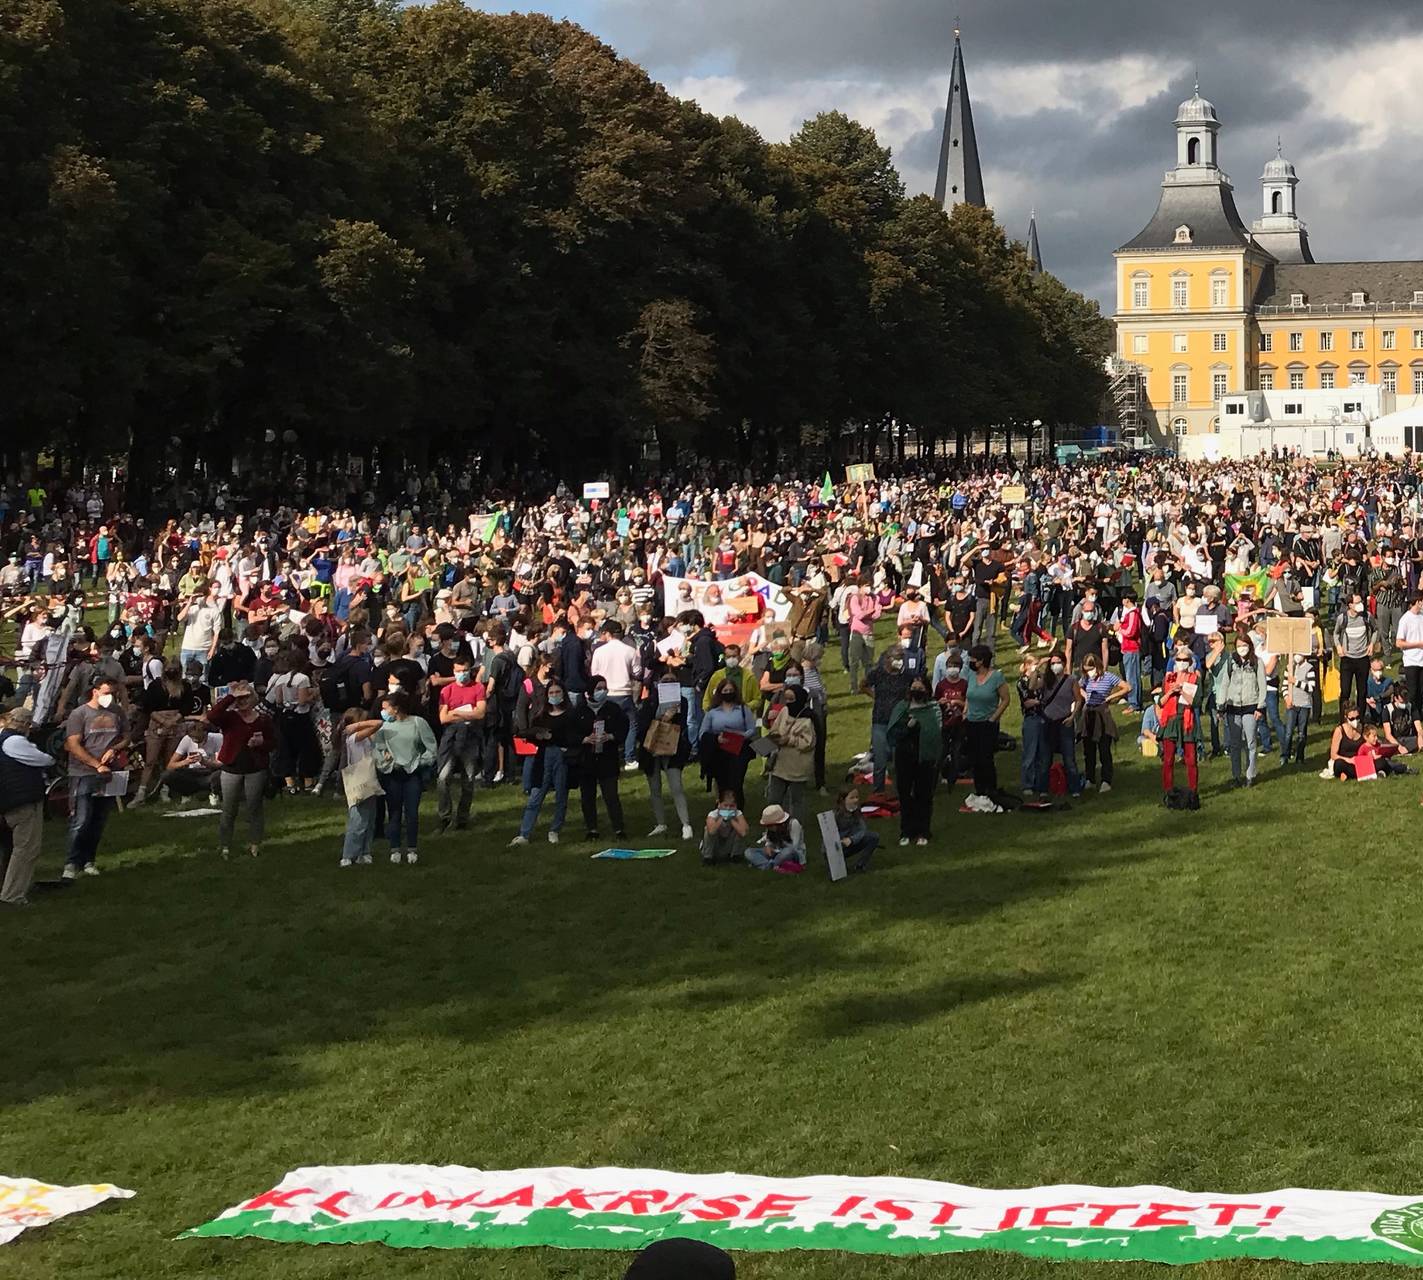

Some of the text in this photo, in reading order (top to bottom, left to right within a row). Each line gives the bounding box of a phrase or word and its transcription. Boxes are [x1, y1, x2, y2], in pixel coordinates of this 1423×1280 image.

[240, 1184, 1287, 1231] KLIMAKRISE IST JETZT!
